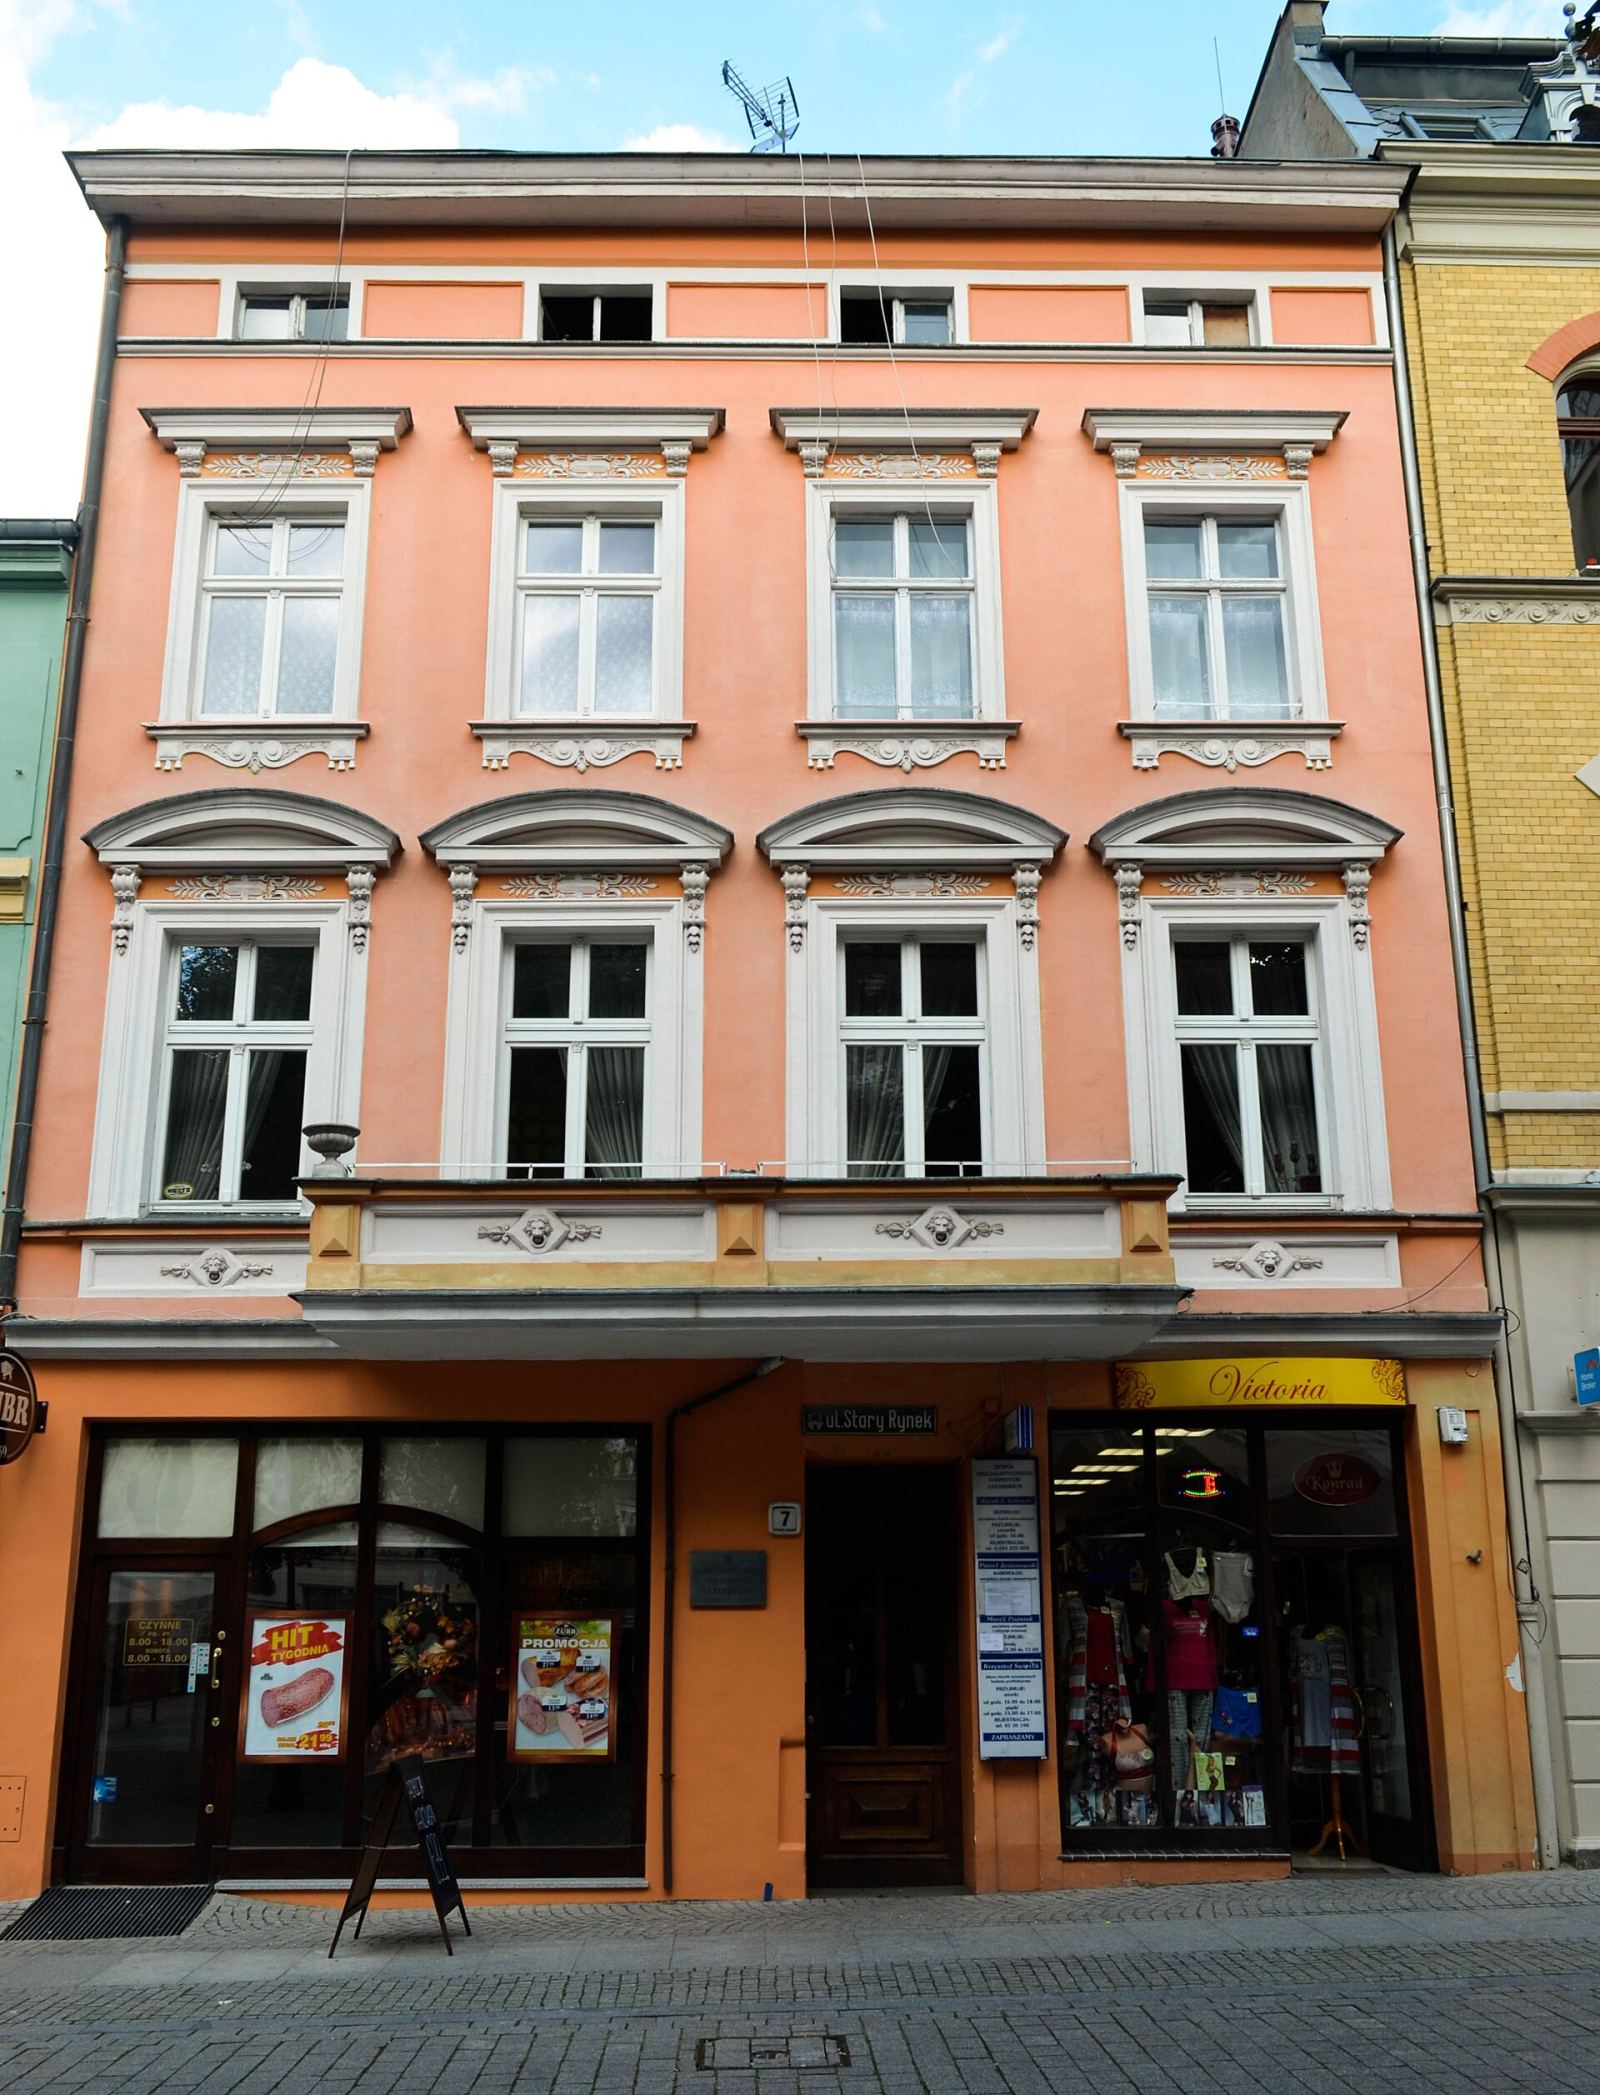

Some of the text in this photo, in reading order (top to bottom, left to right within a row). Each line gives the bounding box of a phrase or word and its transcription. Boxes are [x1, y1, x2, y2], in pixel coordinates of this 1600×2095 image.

[1209, 1361, 1328, 1403] Victoria
[888, 1409, 932, 1433] Rynek
[1304, 1473, 1365, 1496] Konrad
[781, 1511, 791, 1527] 7
[139, 1621, 182, 1630] CZYNNE
[129, 1638, 151, 1646] 8.00
[161, 1638, 189, 1646] 18.00
[271, 1626, 314, 1650] HIT
[522, 1638, 609, 1648] PROMOCJA
[127, 1654, 150, 1663] 8.00
[159, 1654, 187, 1663] 15.00
[271, 1644, 329, 1661] TYGODNIA
[299, 1734, 317, 1748] 21
[319, 1733, 332, 1742] 99
